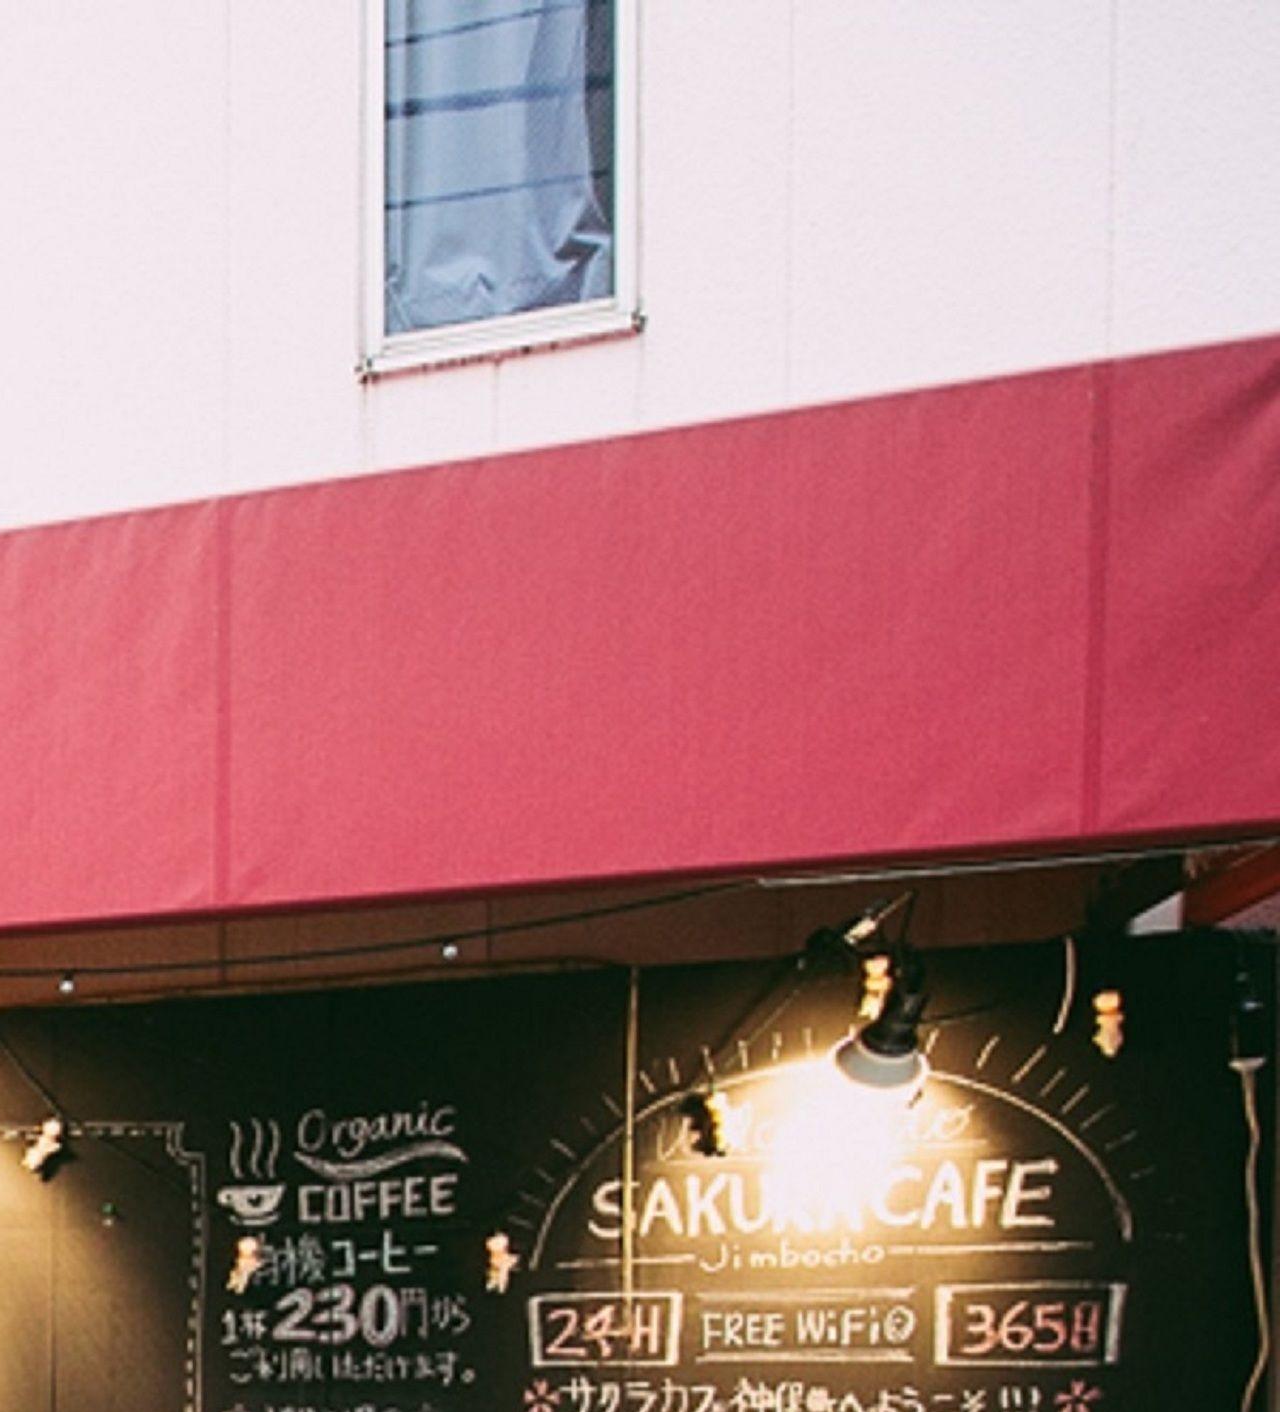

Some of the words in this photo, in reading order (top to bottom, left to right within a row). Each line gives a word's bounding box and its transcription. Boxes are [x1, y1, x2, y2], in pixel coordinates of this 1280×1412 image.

[297, 1101, 458, 1158] Organic
[297, 1173, 459, 1224] COFFEE
[877, 1157, 1058, 1231] CAFE
[697, 1241, 887, 1275] Jimbocho
[545, 1306, 660, 1360] 24H
[701, 1309, 786, 1351] FREE
